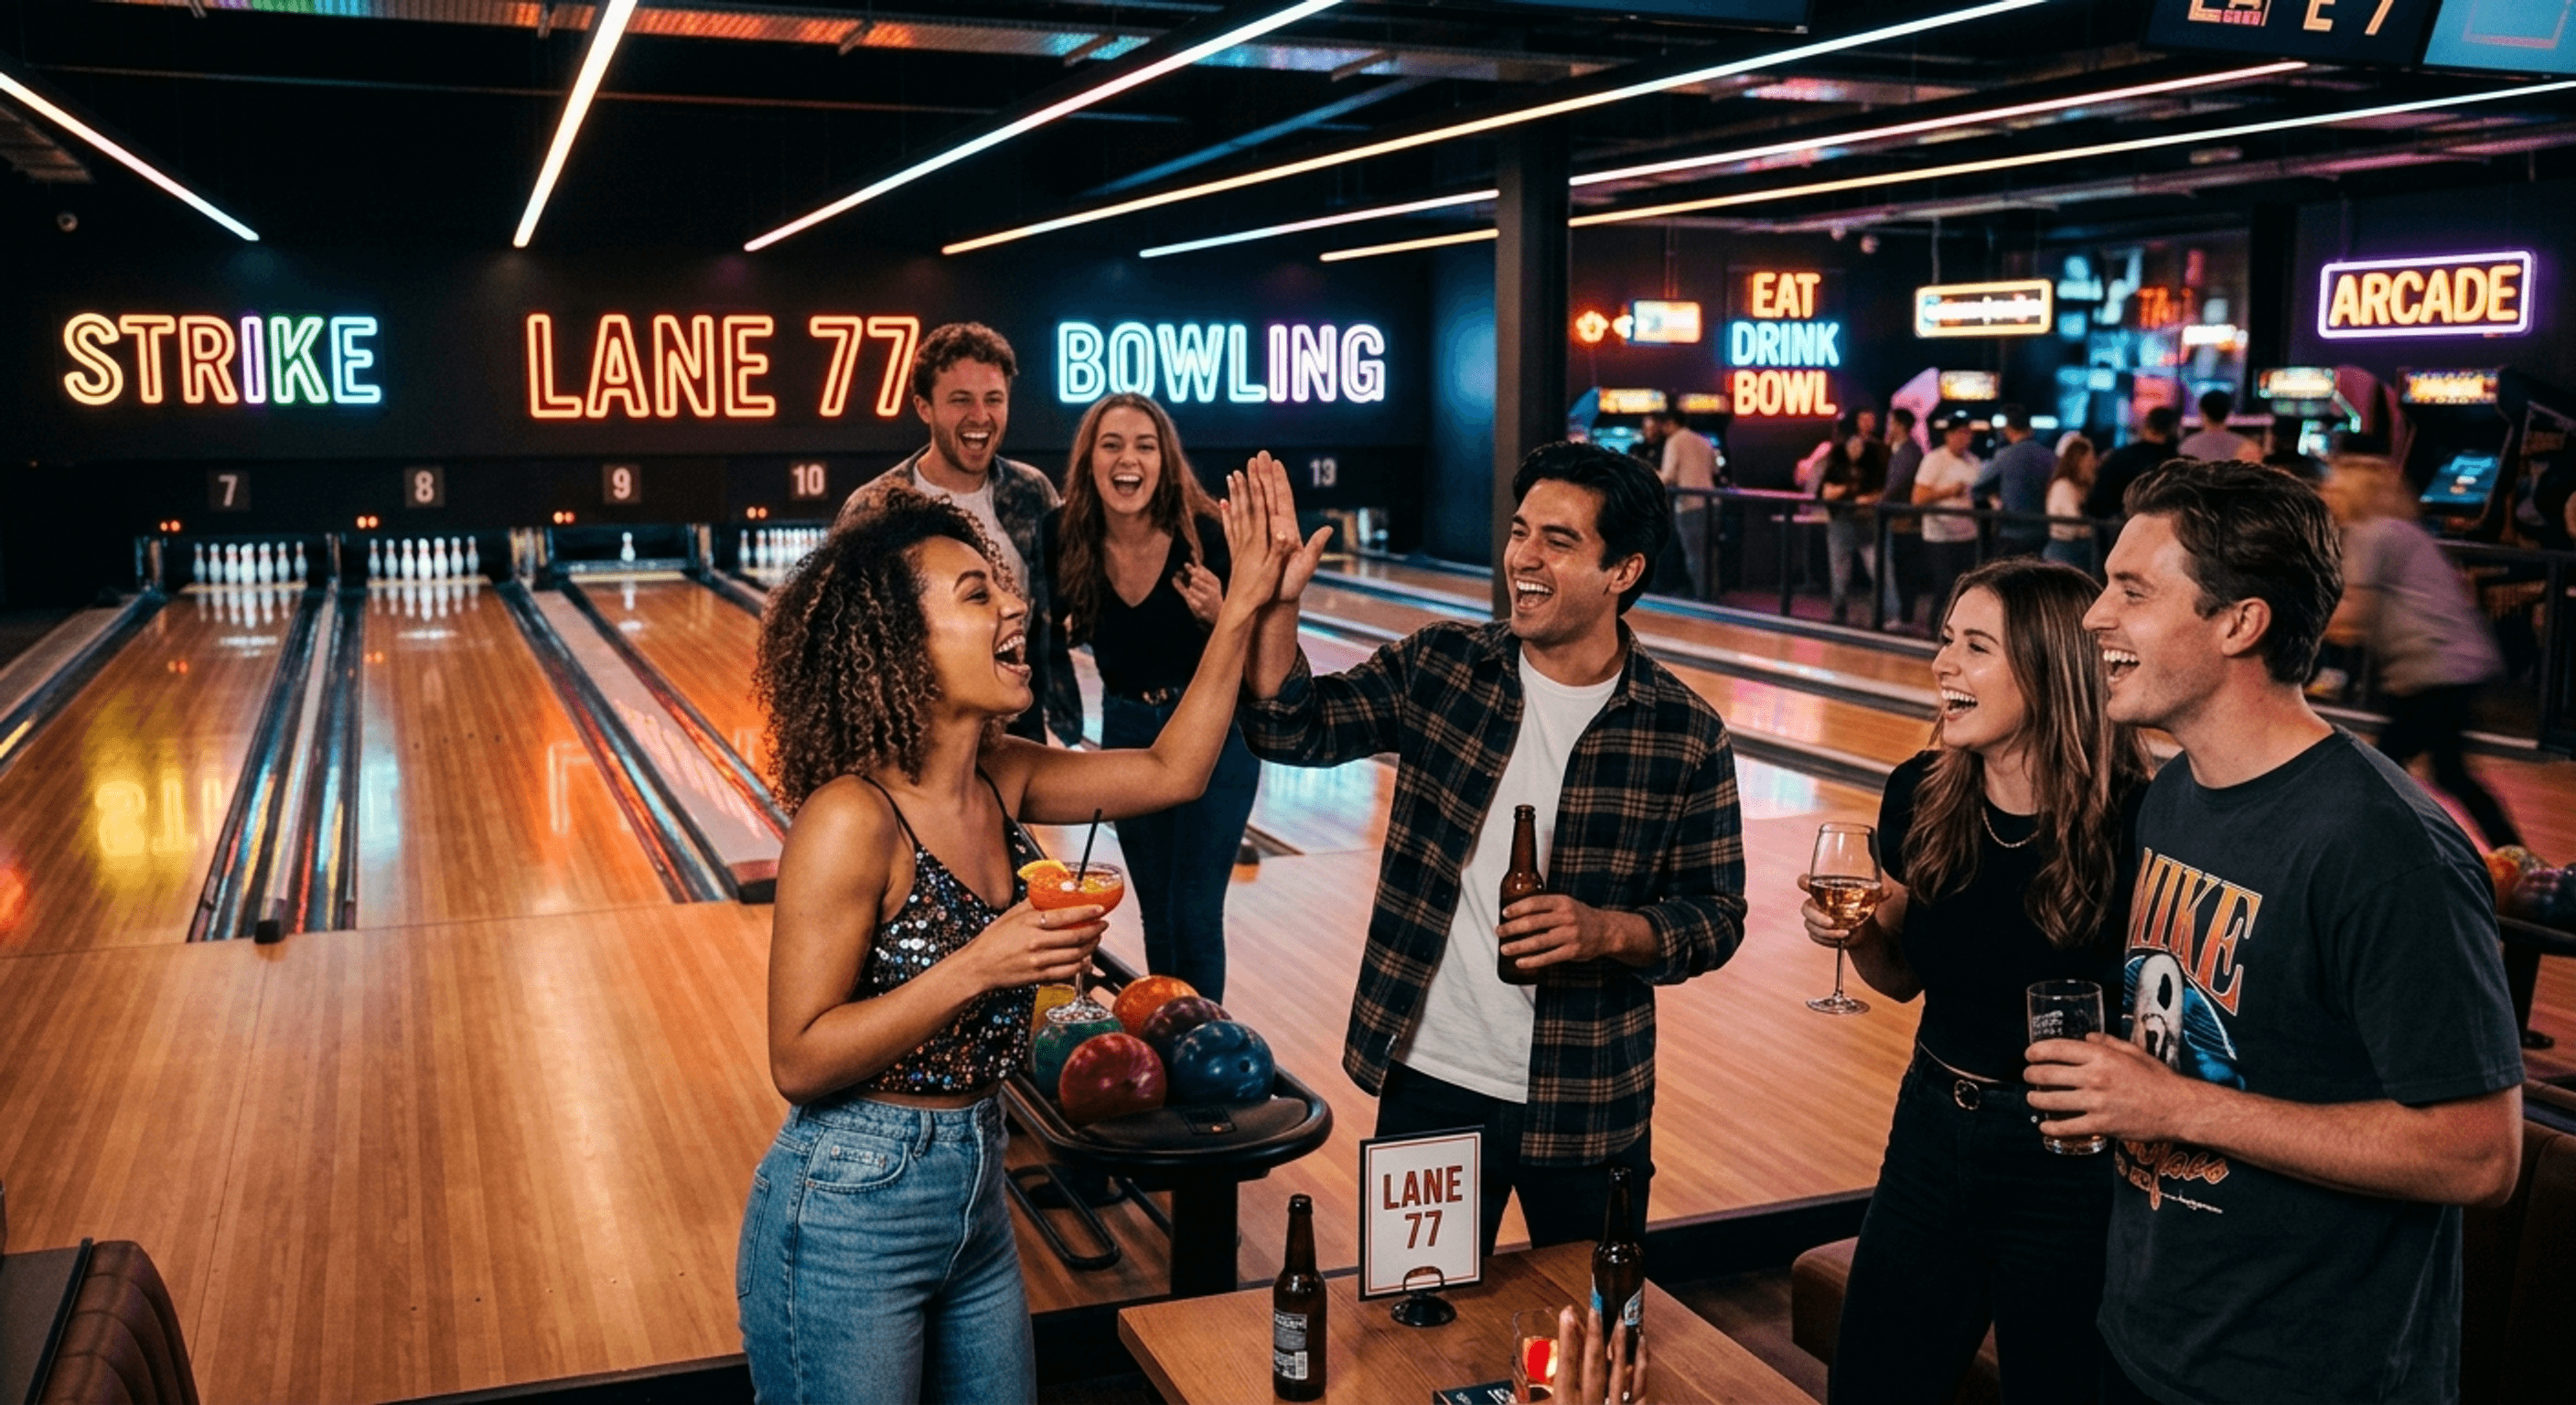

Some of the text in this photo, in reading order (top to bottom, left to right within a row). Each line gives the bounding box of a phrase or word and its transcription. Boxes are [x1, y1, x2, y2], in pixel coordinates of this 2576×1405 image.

[1752, 272, 1820, 318] EAT
[2328, 264, 2522, 327] ARCADE
[64, 313, 381, 405] STRIKE
[527, 314, 919, 418] LANE 77
[1057, 321, 1386, 403] BOWLING
[1731, 322, 1841, 366] DRINK
[1733, 370, 1837, 415] BOWL
[218, 475, 238, 507] 7
[413, 470, 435, 502] 8
[612, 467, 632, 499] 9
[792, 464, 824, 496] 10
[1309, 458, 1337, 488] 13
[1382, 1164, 1464, 1210] LANE
[1404, 1209, 1444, 1249] 77
